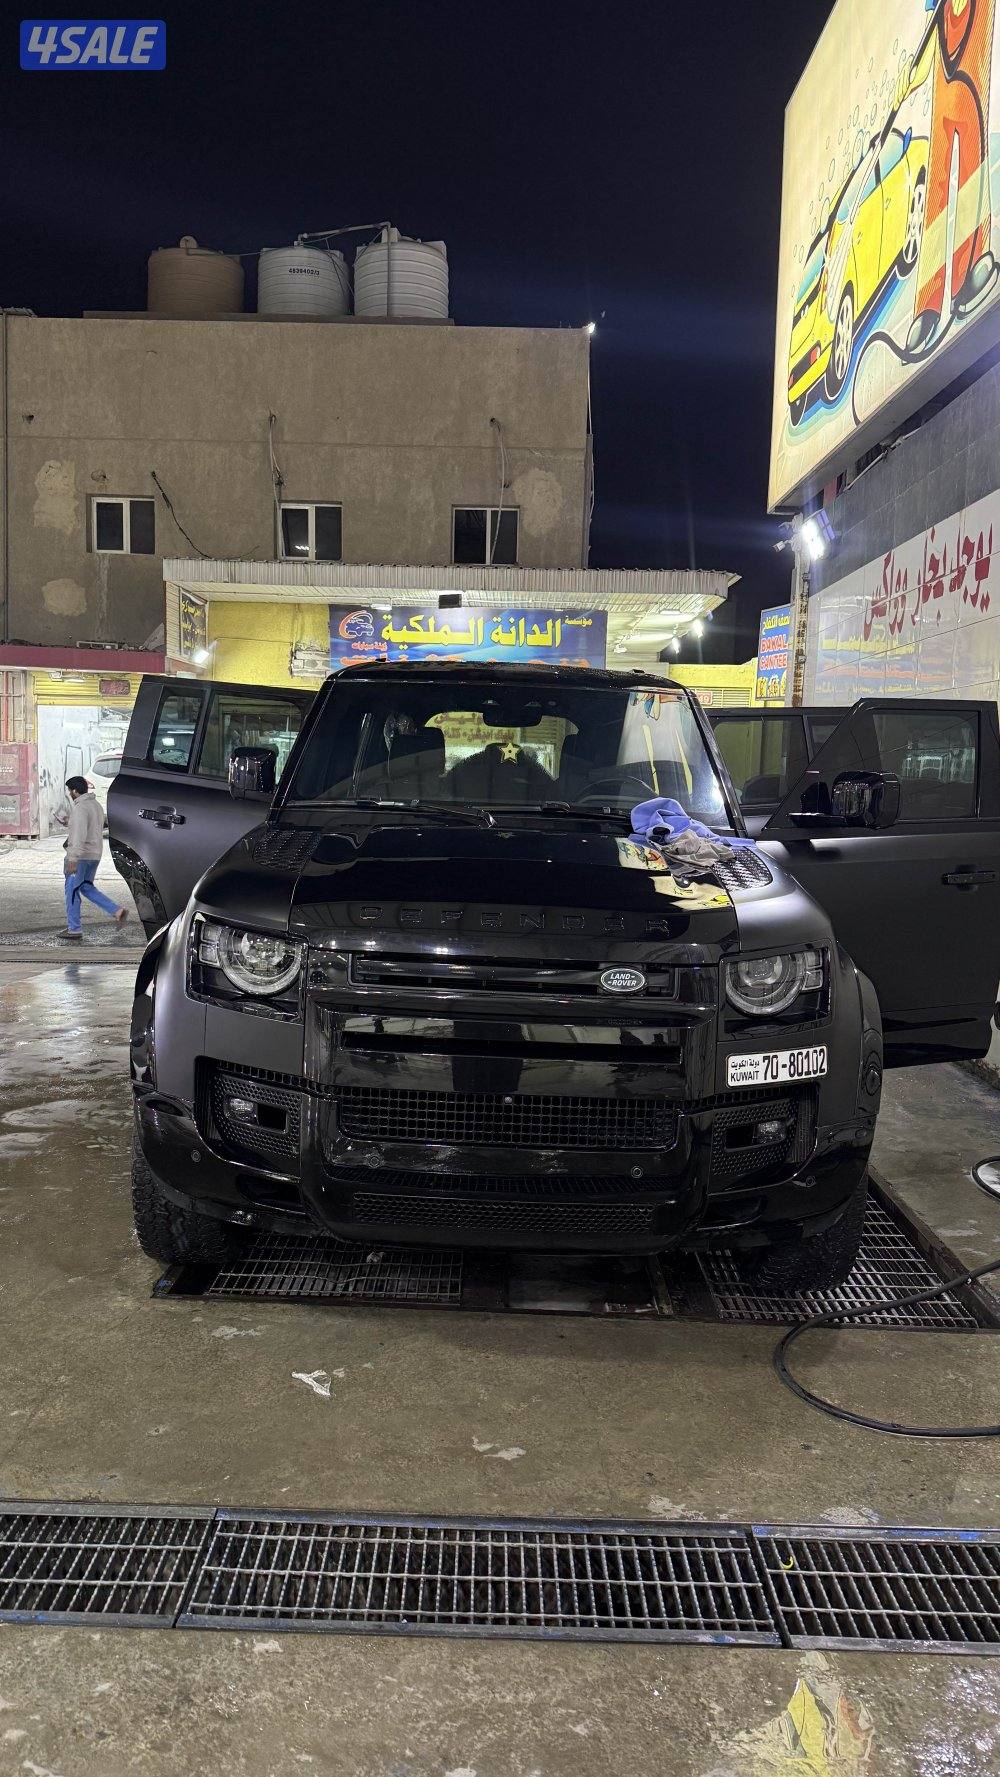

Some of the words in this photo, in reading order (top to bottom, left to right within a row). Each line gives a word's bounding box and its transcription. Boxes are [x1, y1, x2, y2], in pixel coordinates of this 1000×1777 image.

[910, 526, 947, 627] بخار
[381, 614, 484, 651] الملكية
[490, 616, 562, 648] الدانة
[730, 1059, 749, 1071] الكويت
[730, 1070, 760, 1083] KUWAIT
[748, 1058, 760, 1069] دولة
[762, 1048, 826, 1081] 70-80102
